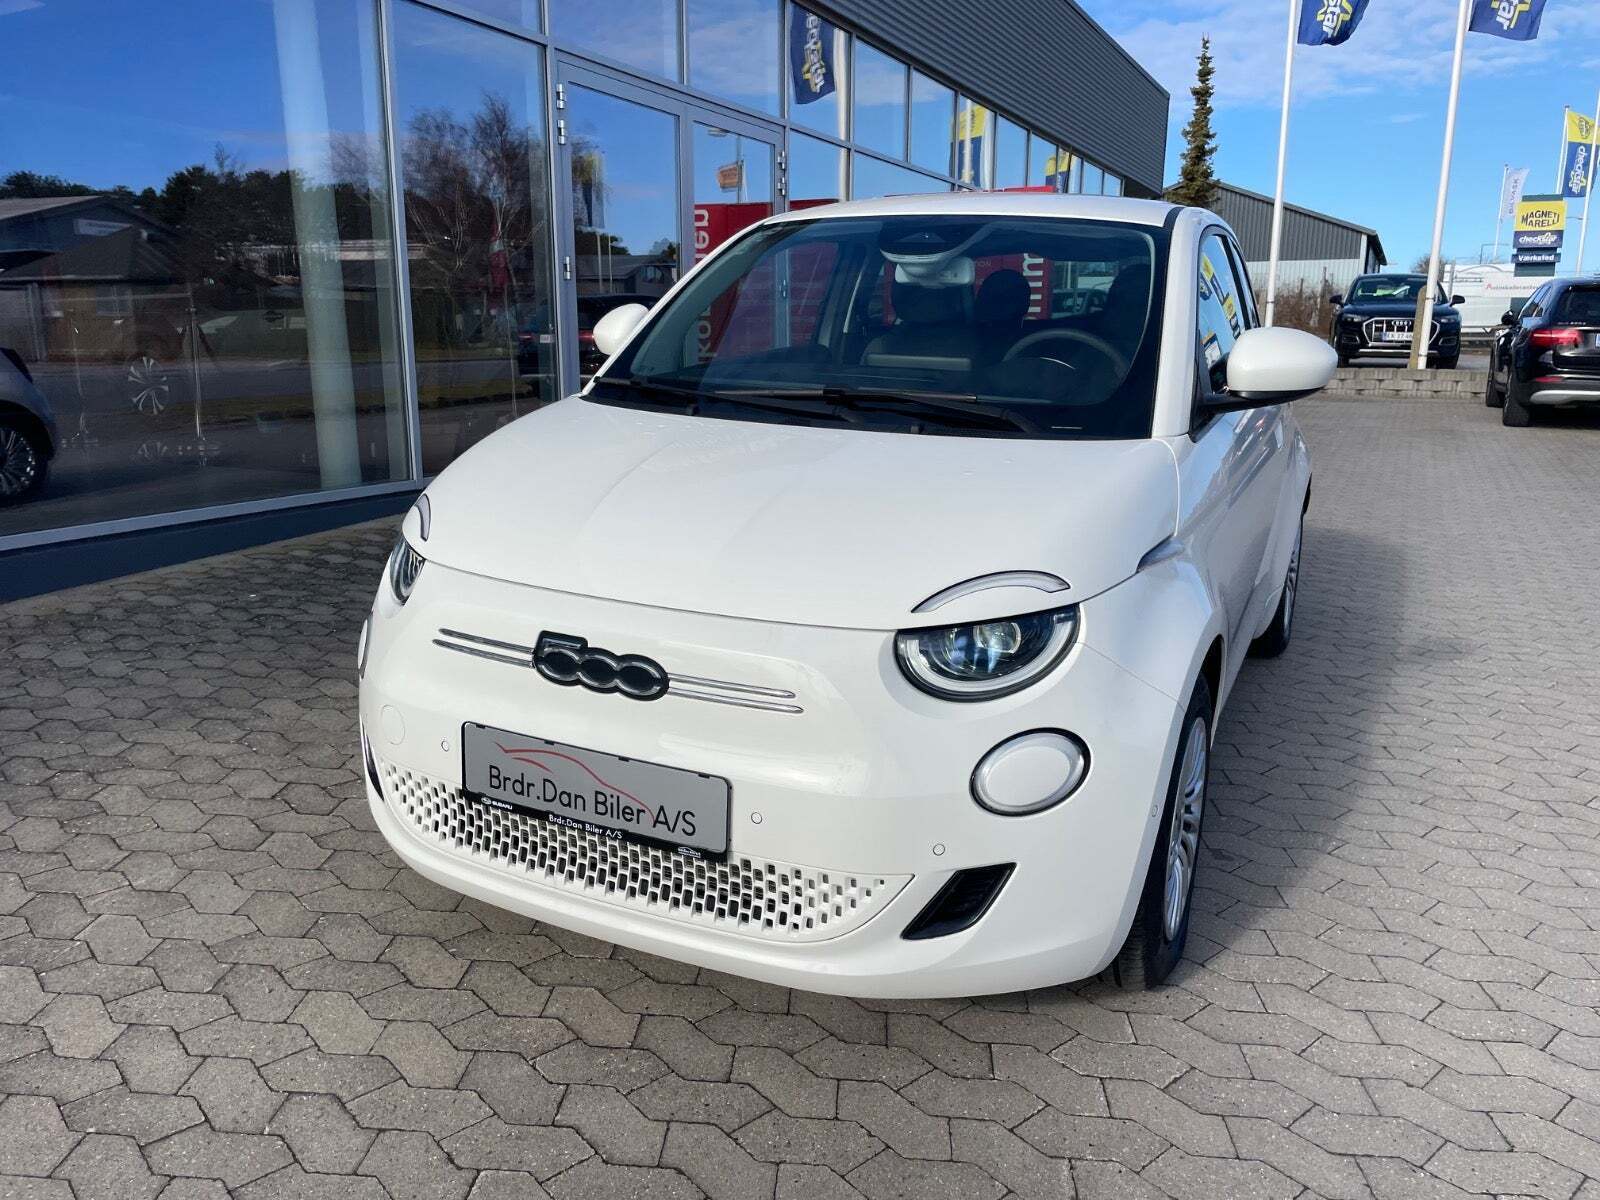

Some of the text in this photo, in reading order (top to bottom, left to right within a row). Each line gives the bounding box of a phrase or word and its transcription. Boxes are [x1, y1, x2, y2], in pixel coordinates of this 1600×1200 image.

[1521, 210, 1560, 222] MAGNETI
[1521, 218, 1559, 228] MARELLI
[532, 630, 669, 701] 500
[489, 764, 697, 837] Brdr.Dan Biler A/S
[548, 814, 623, 839] Brdr.Dan Biler A/S
